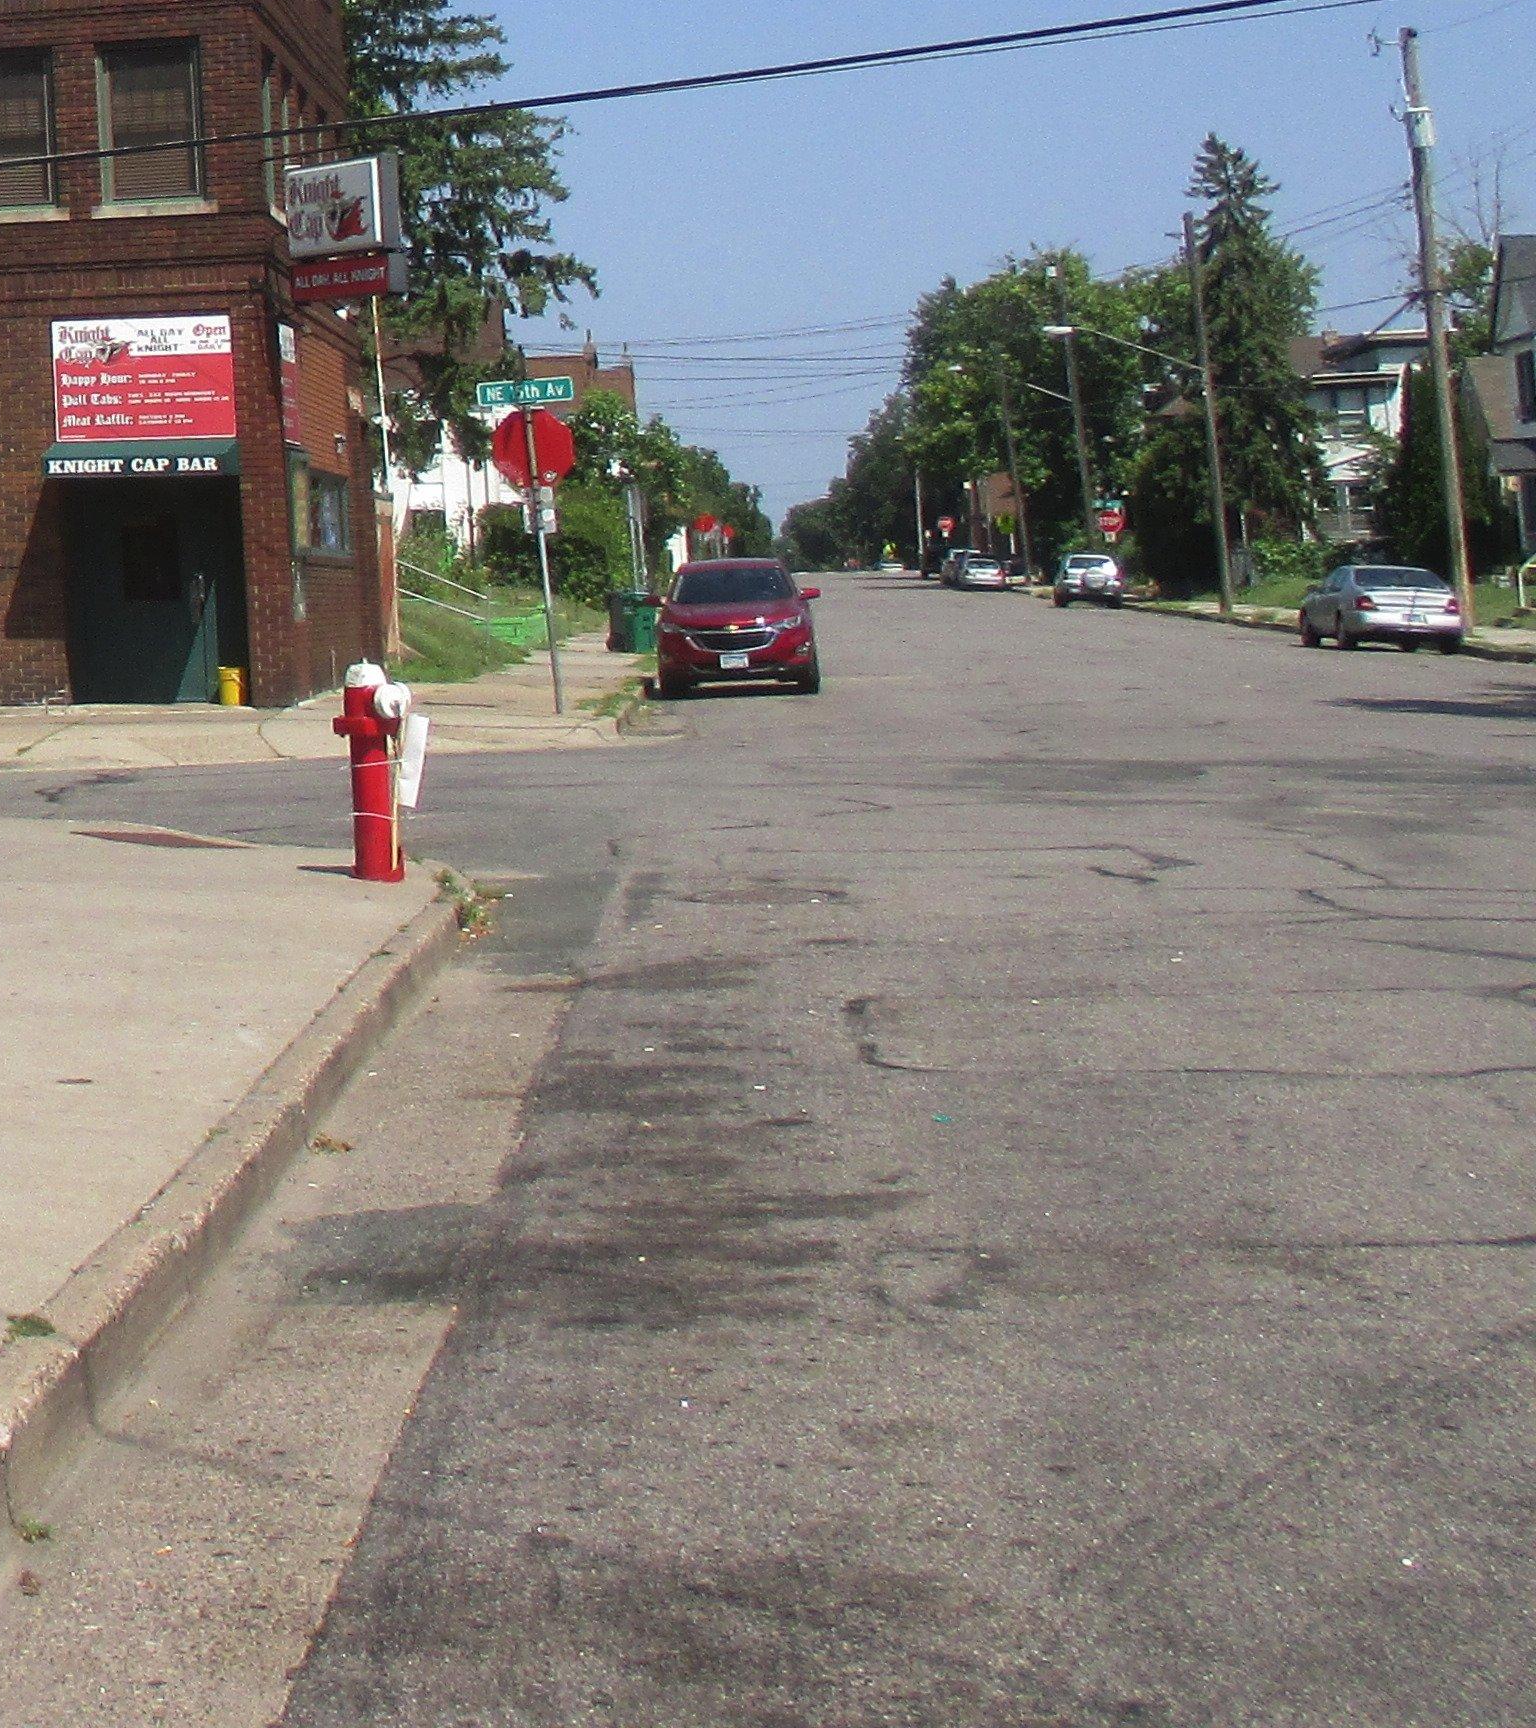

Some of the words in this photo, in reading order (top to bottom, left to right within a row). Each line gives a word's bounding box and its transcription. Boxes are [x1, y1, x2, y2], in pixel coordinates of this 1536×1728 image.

[58, 325, 110, 344] Knight
[137, 344, 179, 352] KNIGHT
[485, 386, 505, 402] NE
[545, 382, 565, 397] Av
[61, 394, 88, 408] Pull
[62, 414, 91, 428] Meat
[48, 458, 124, 474] KNIGHT
[131, 457, 170, 472] CAP
[177, 457, 219, 471] BAR
